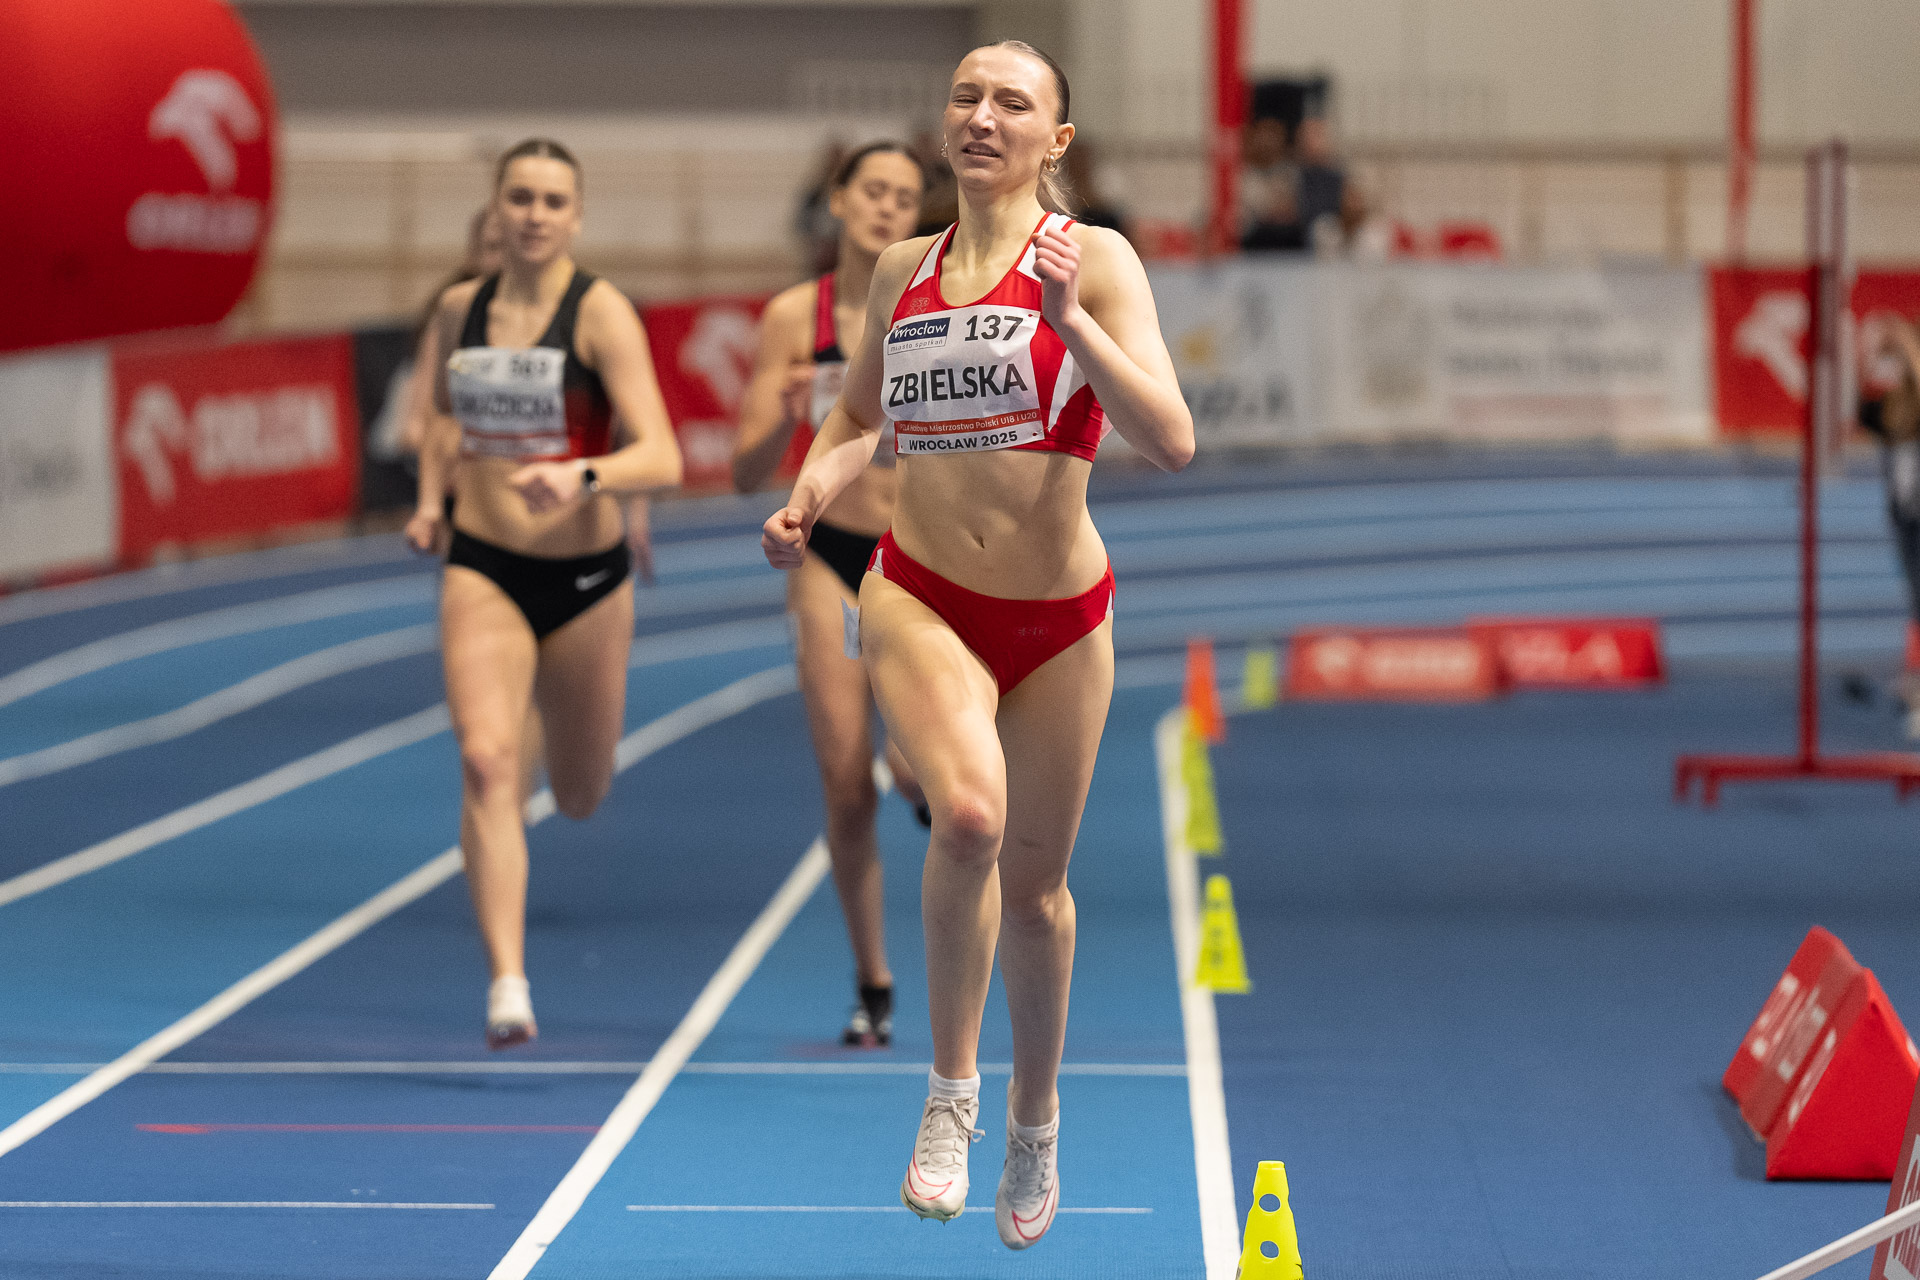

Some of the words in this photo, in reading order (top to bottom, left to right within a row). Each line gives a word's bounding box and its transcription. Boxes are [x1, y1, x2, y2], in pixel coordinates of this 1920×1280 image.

[964, 314, 1024, 342] 137
[888, 363, 1028, 408] ZBIELSKA
[929, 423, 974, 432] Mistrzostwa
[975, 418, 999, 429] Polski
[1000, 415, 1015, 425] U18
[1021, 411, 1037, 421] U20
[909, 438, 977, 451] WROCŁAW
[981, 431, 1018, 447] 2025
